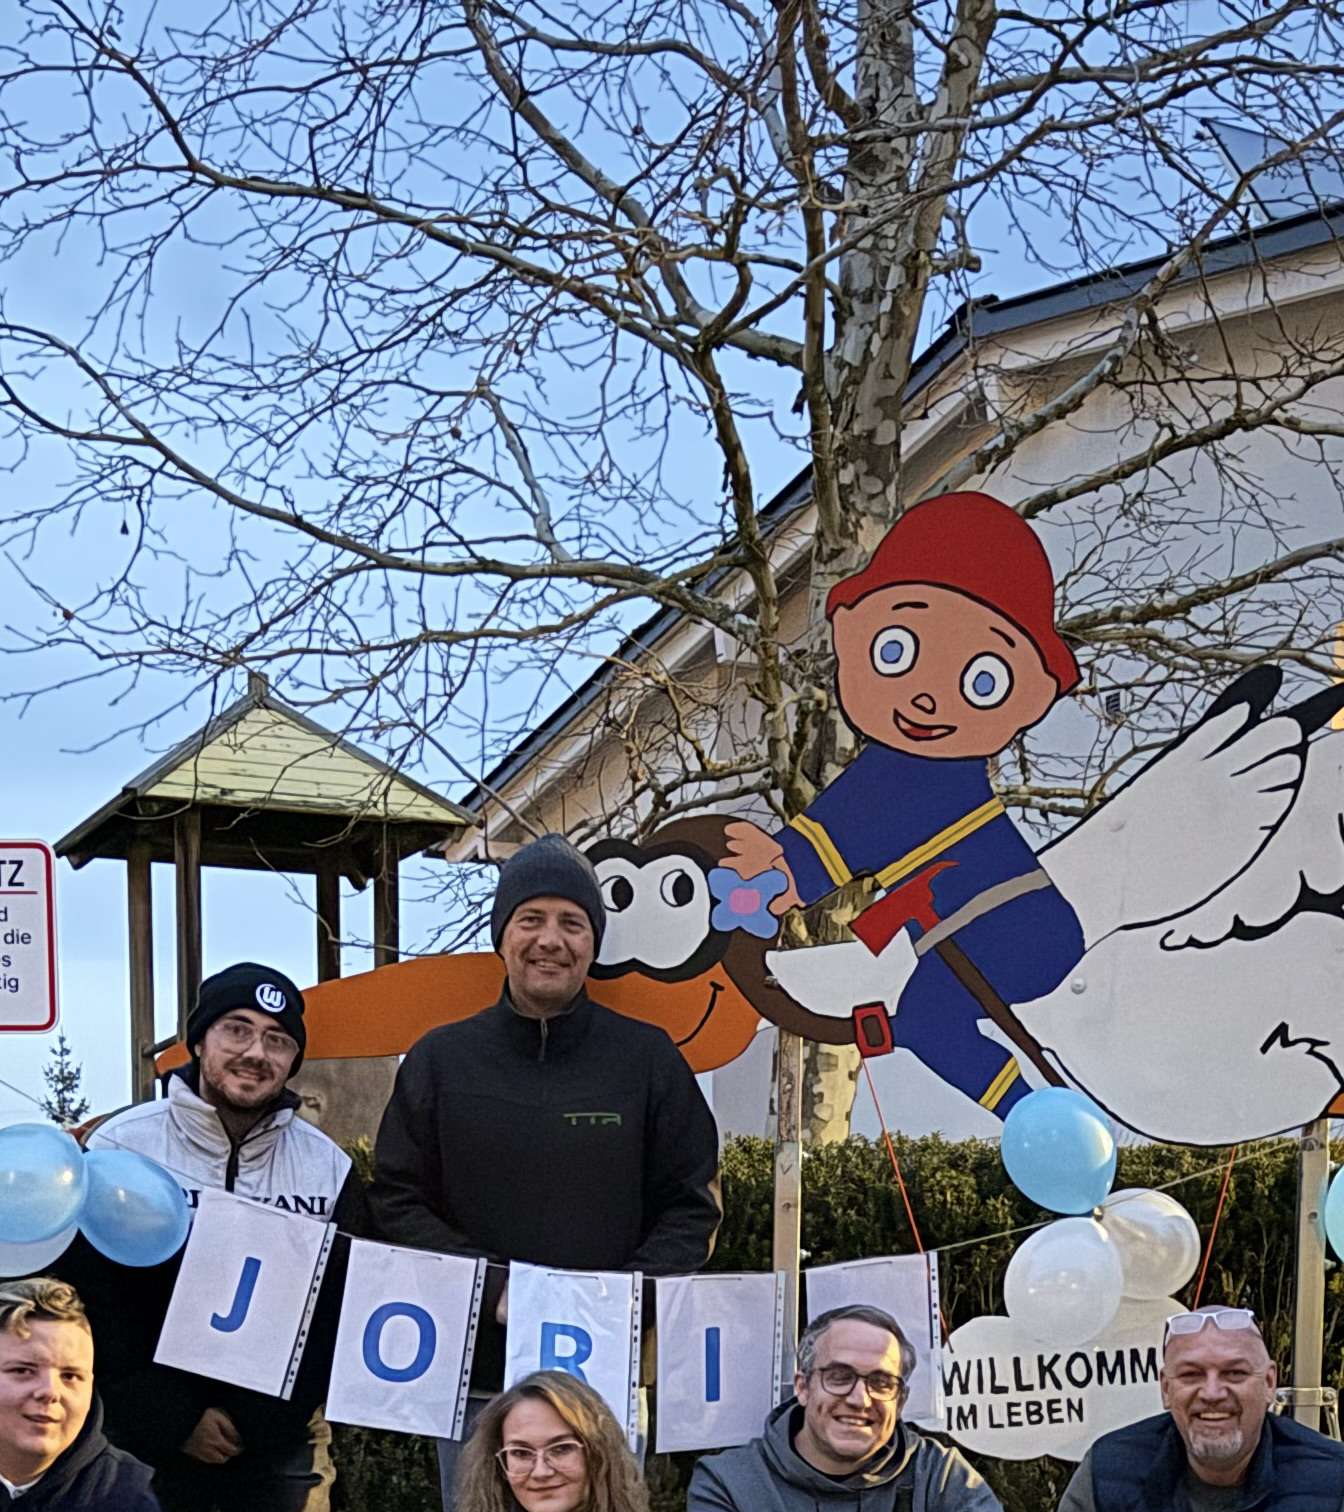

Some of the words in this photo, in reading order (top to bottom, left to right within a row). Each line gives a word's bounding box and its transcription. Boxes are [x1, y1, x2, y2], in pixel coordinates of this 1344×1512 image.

[3, 929, 32, 945] die
[946, 1404, 977, 1431] IM
[989, 1398, 1084, 1429] LEBEN
